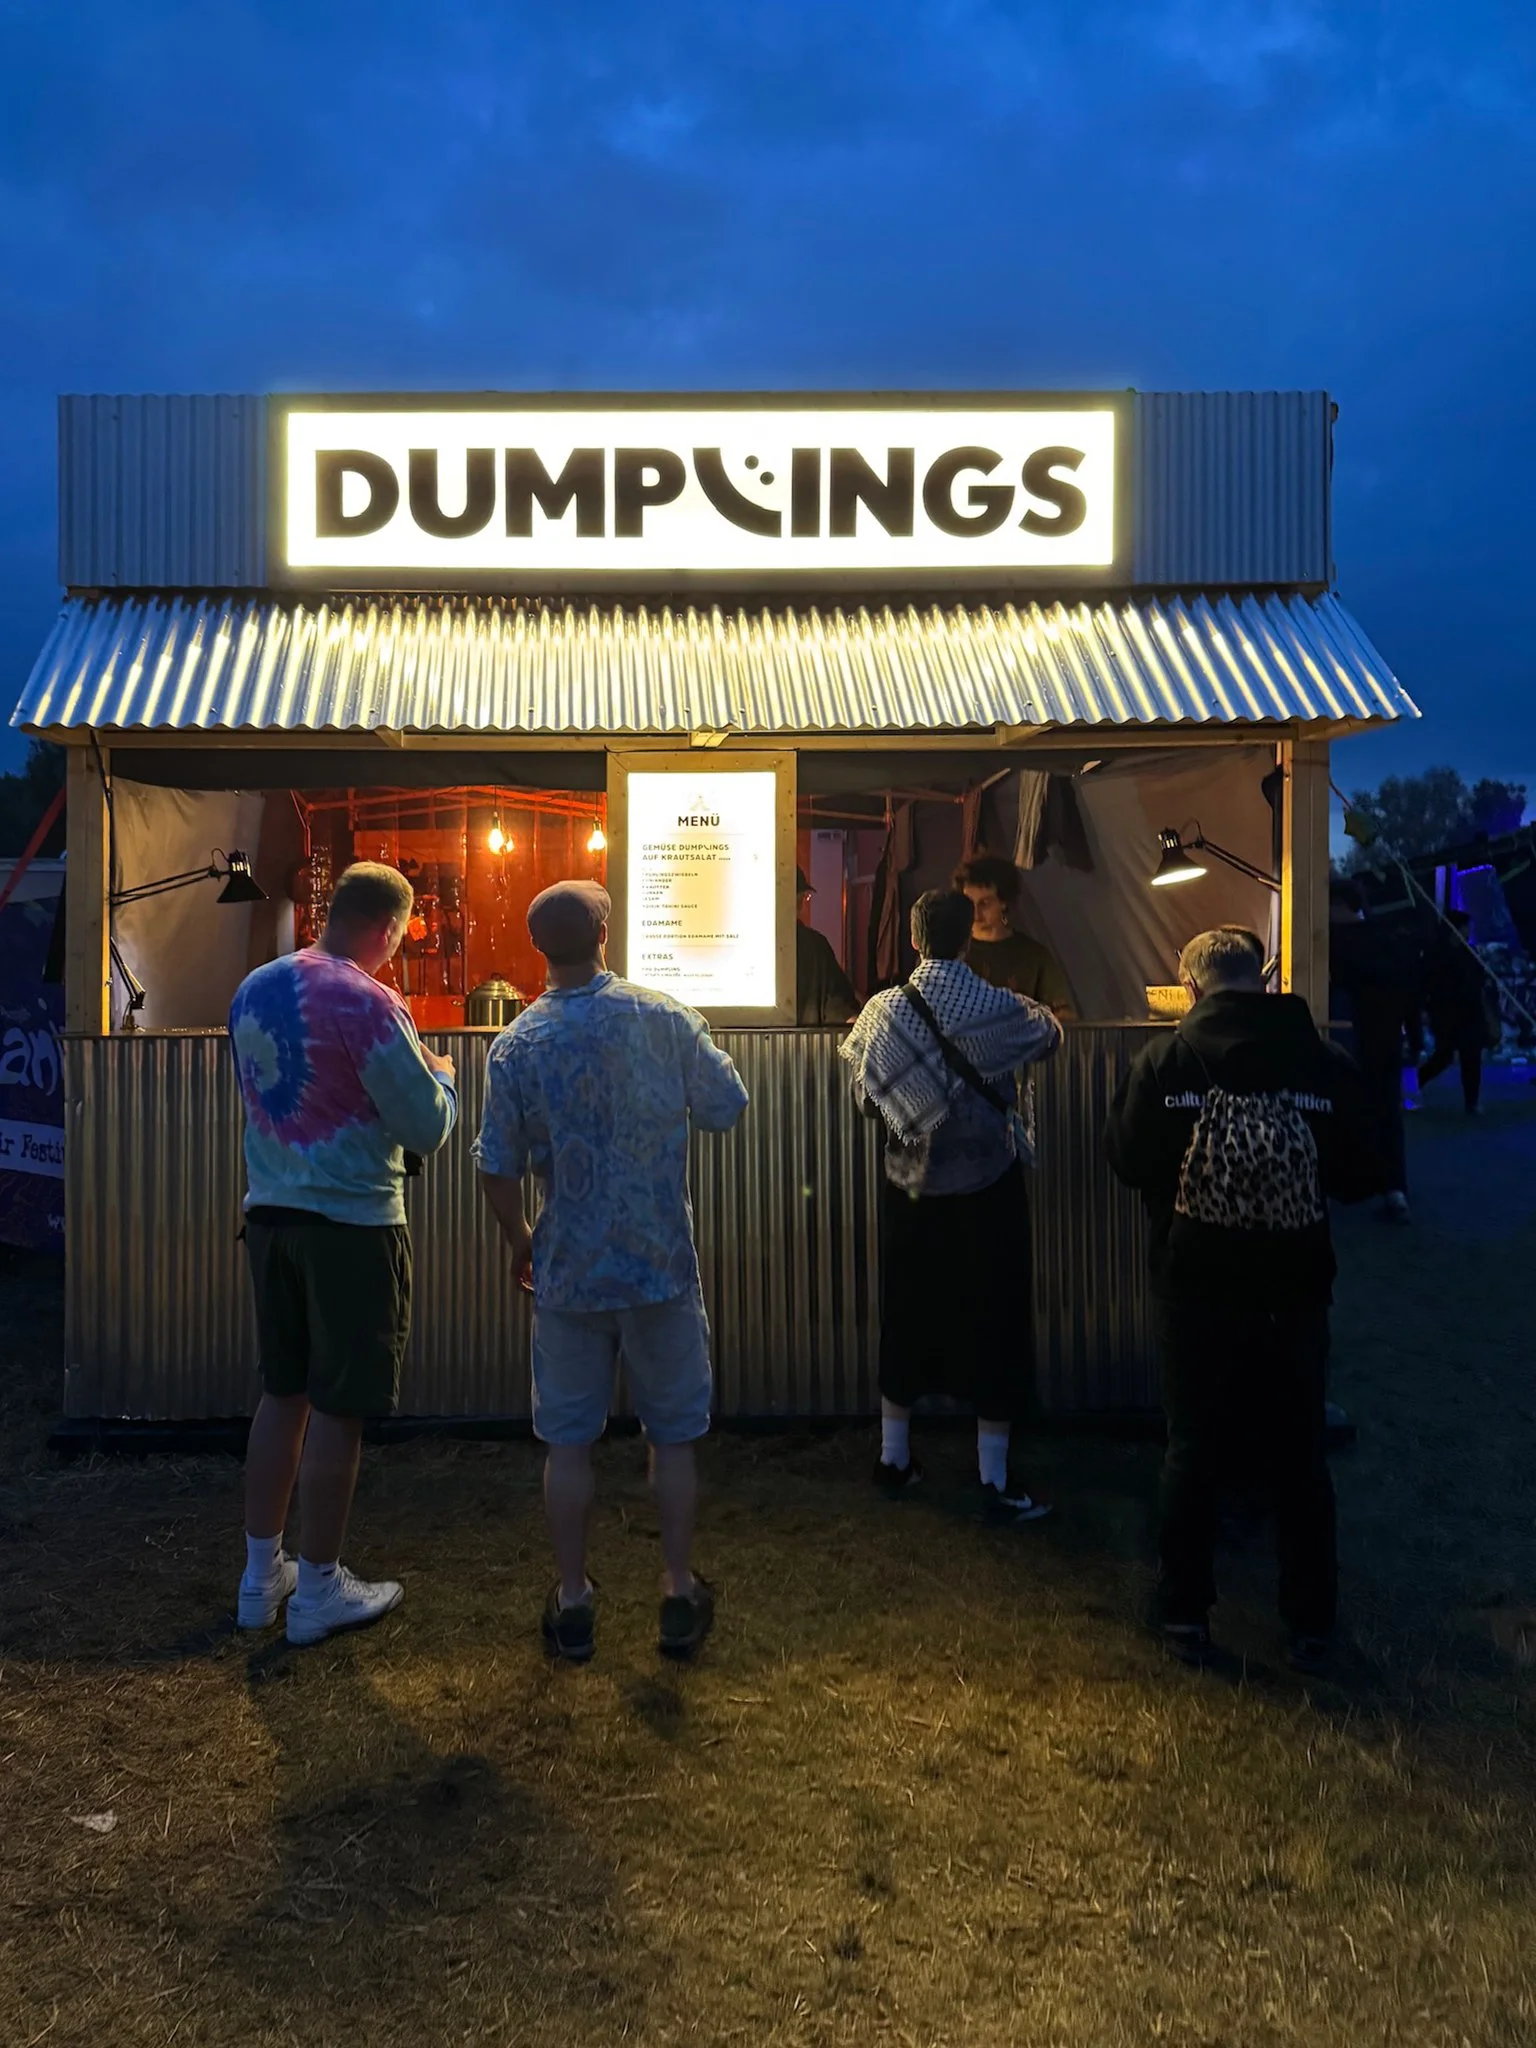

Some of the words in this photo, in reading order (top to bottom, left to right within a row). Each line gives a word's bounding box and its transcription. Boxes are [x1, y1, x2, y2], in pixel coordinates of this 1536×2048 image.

[315, 446, 1087, 538] DUMPLINGS
[678, 813, 720, 827] MENÜ
[642, 843, 677, 851] GEMÜSE
[679, 843, 729, 851] DUMPLINGS
[642, 953, 674, 961] EXTRAS
